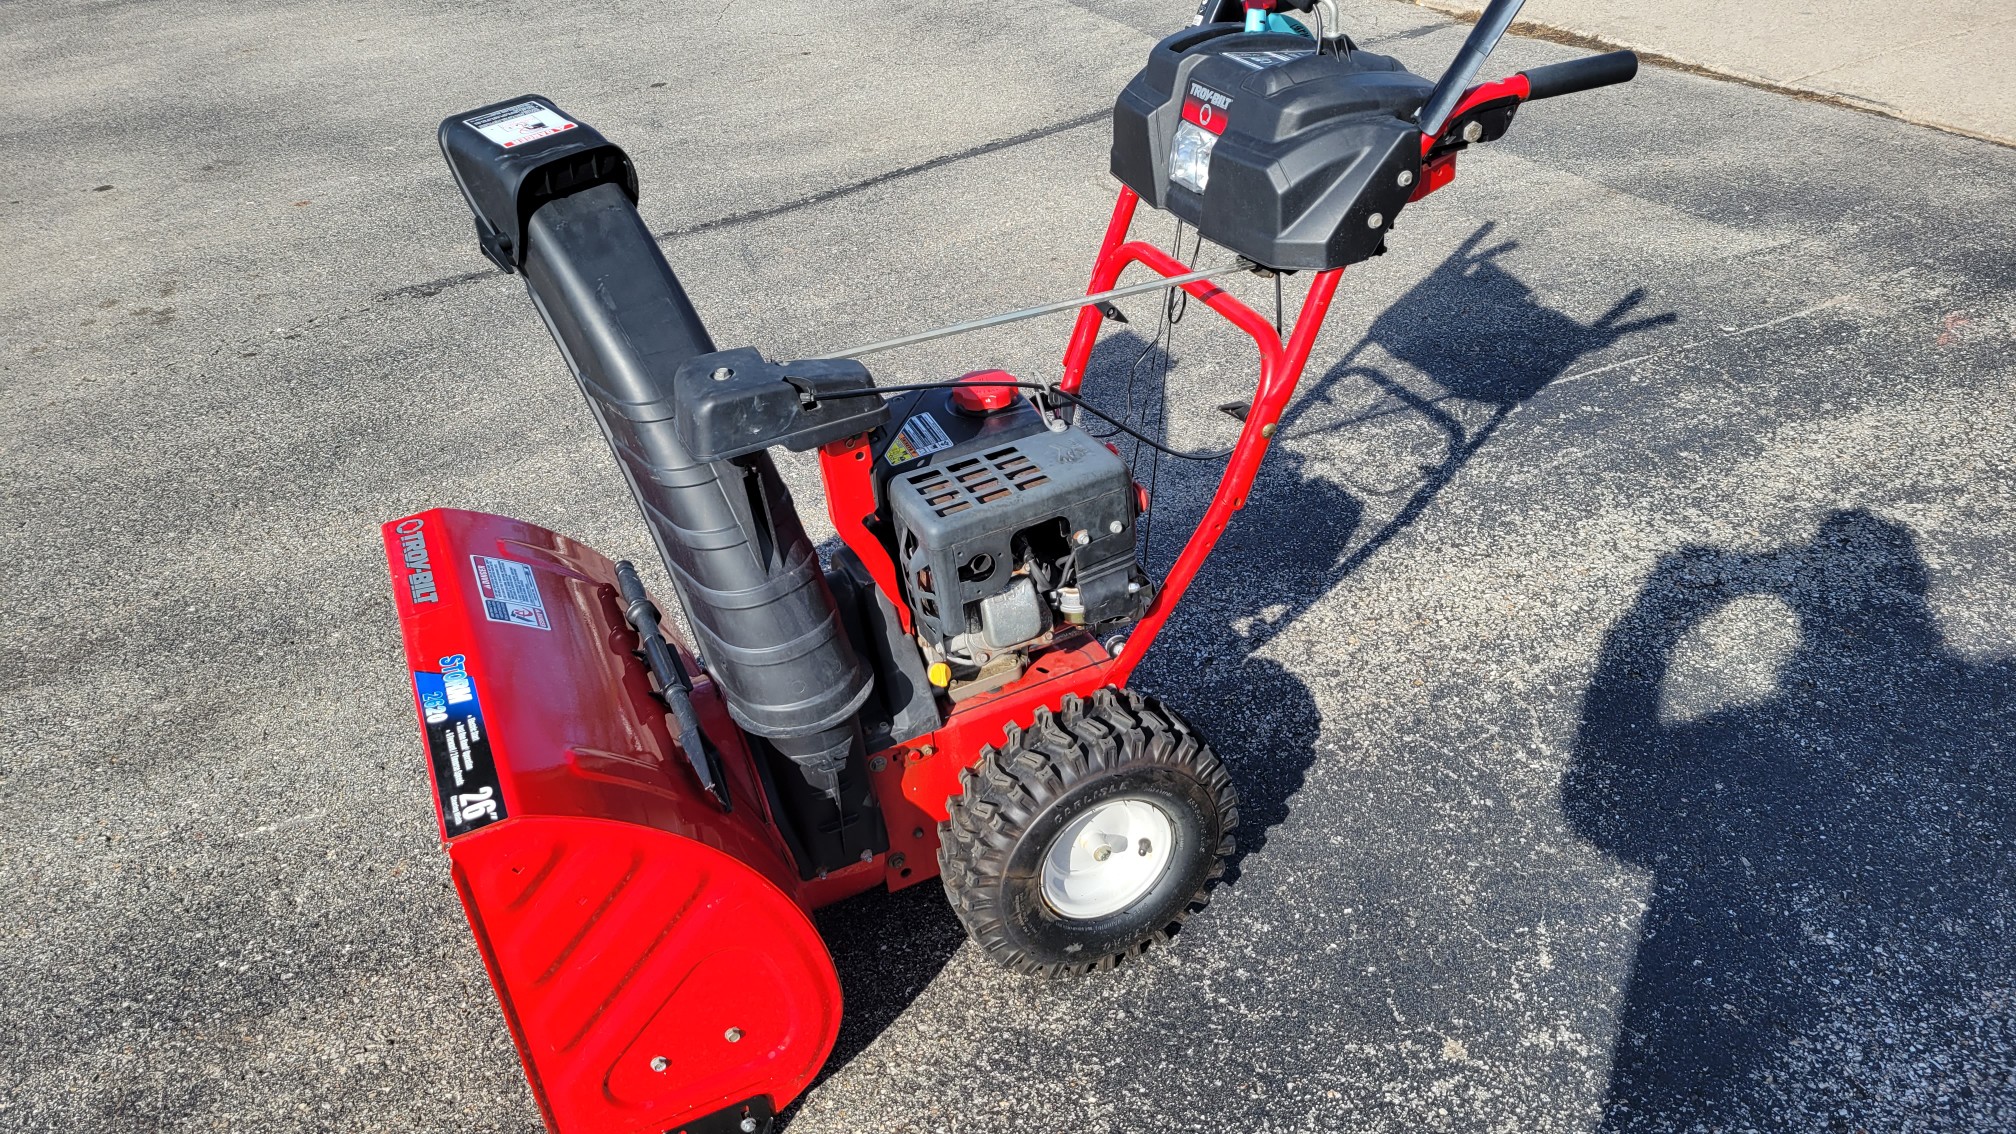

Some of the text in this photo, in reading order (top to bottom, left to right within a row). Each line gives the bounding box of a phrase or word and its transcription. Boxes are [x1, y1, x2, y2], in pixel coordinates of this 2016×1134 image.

[1190, 82, 1233, 110] TROY-BILT
[400, 530, 439, 604] TROY-BILT
[439, 653, 473, 705] STORM
[422, 690, 449, 723] 2620
[1054, 782, 1130, 825] CARLISLE
